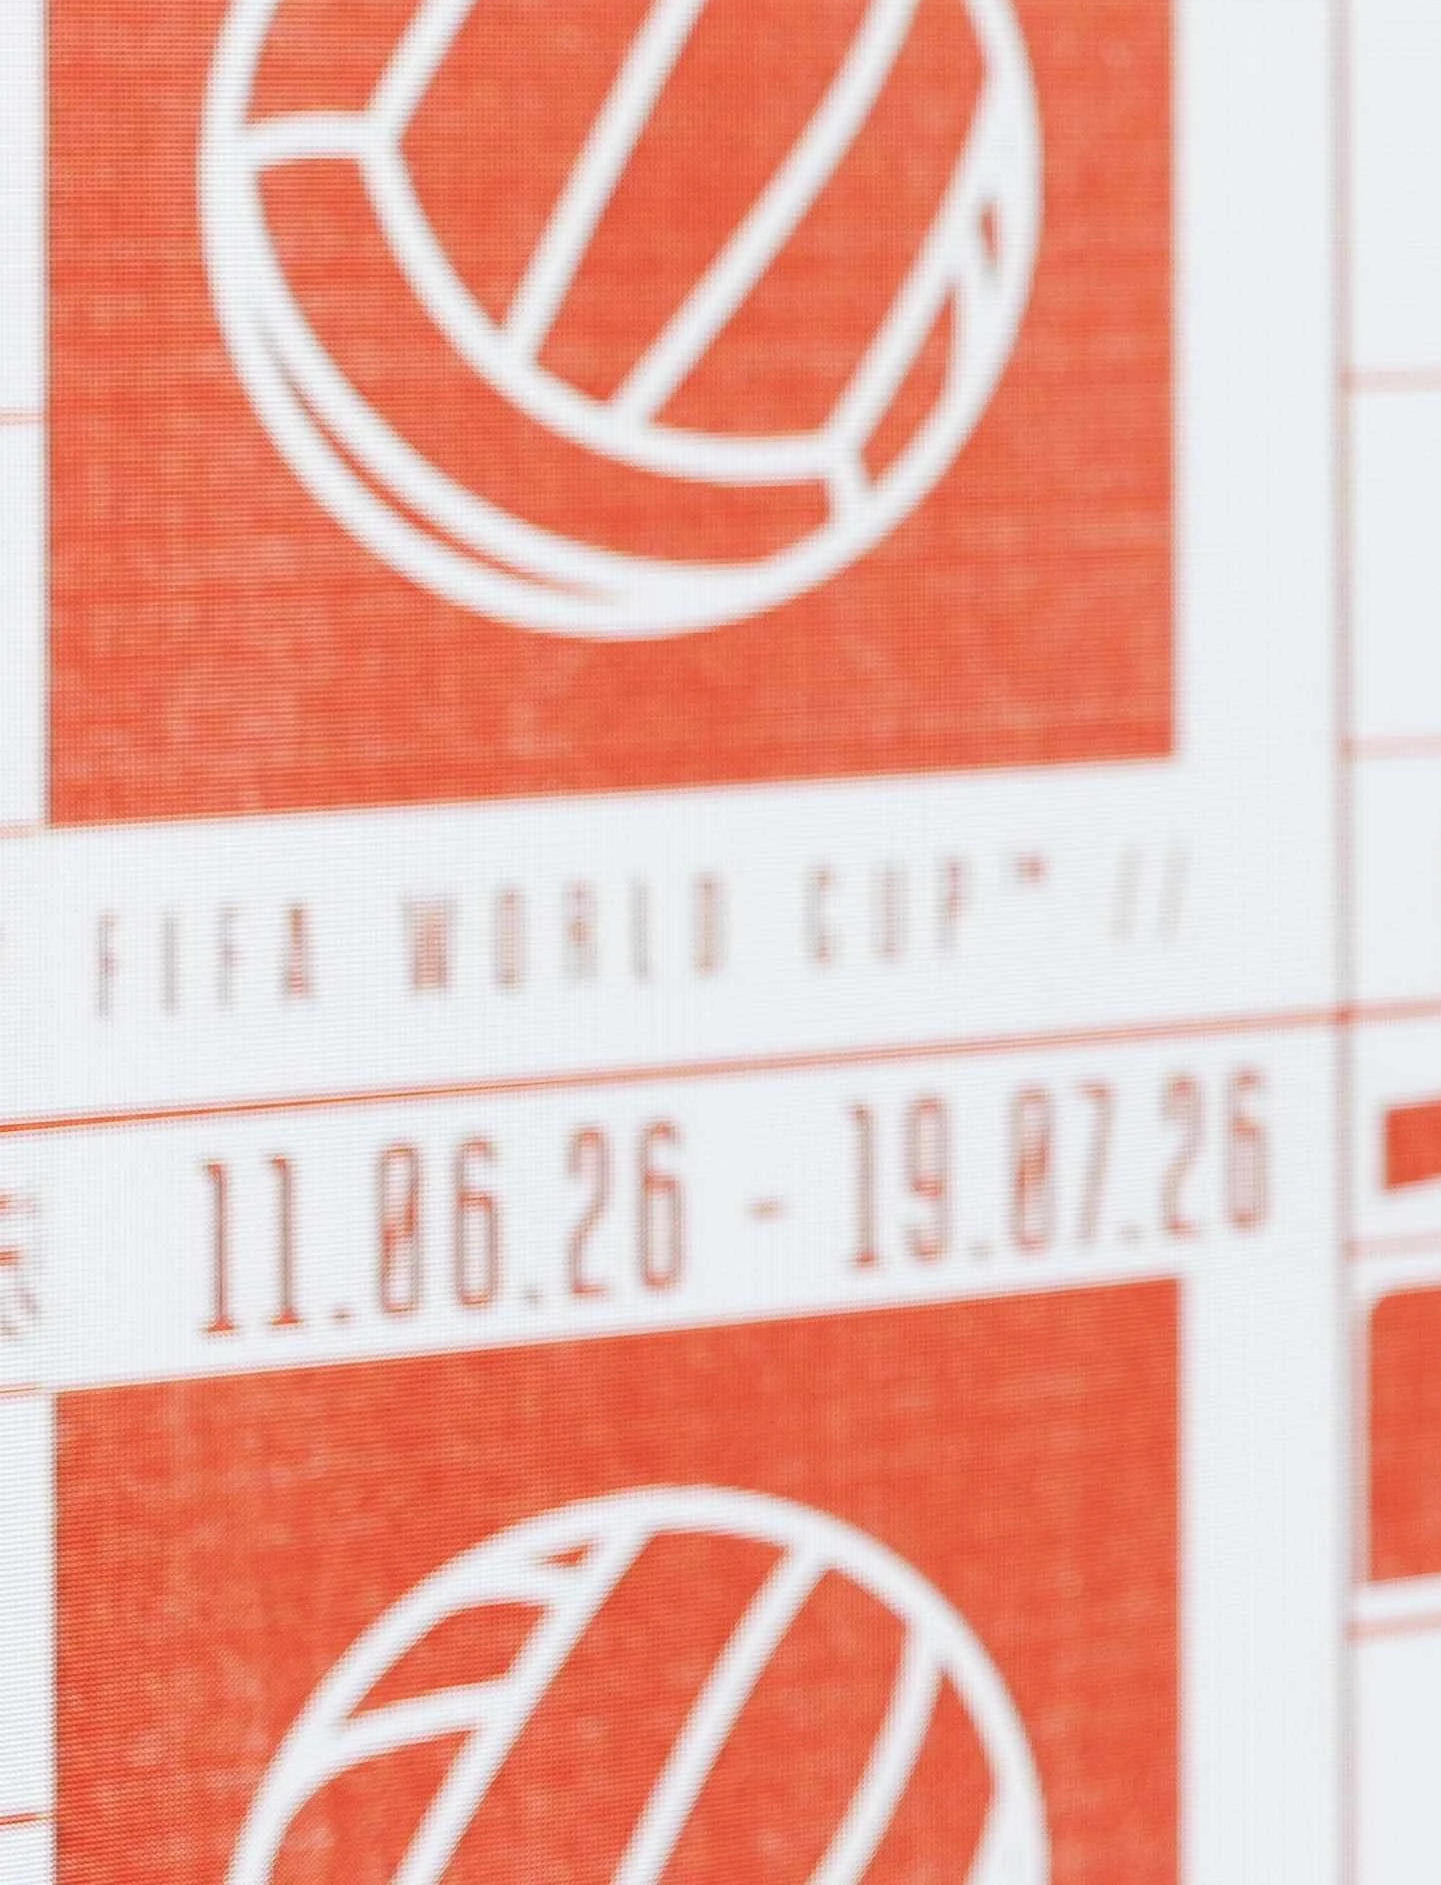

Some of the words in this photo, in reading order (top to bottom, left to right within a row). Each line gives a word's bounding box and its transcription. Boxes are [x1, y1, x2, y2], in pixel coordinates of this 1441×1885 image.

[96, 900, 316, 1016] FIFA
[400, 866, 728, 993] WORLD
[198, 1117, 685, 1335] 11.06.26
[848, 1066, 1268, 1270] 19.07.26
